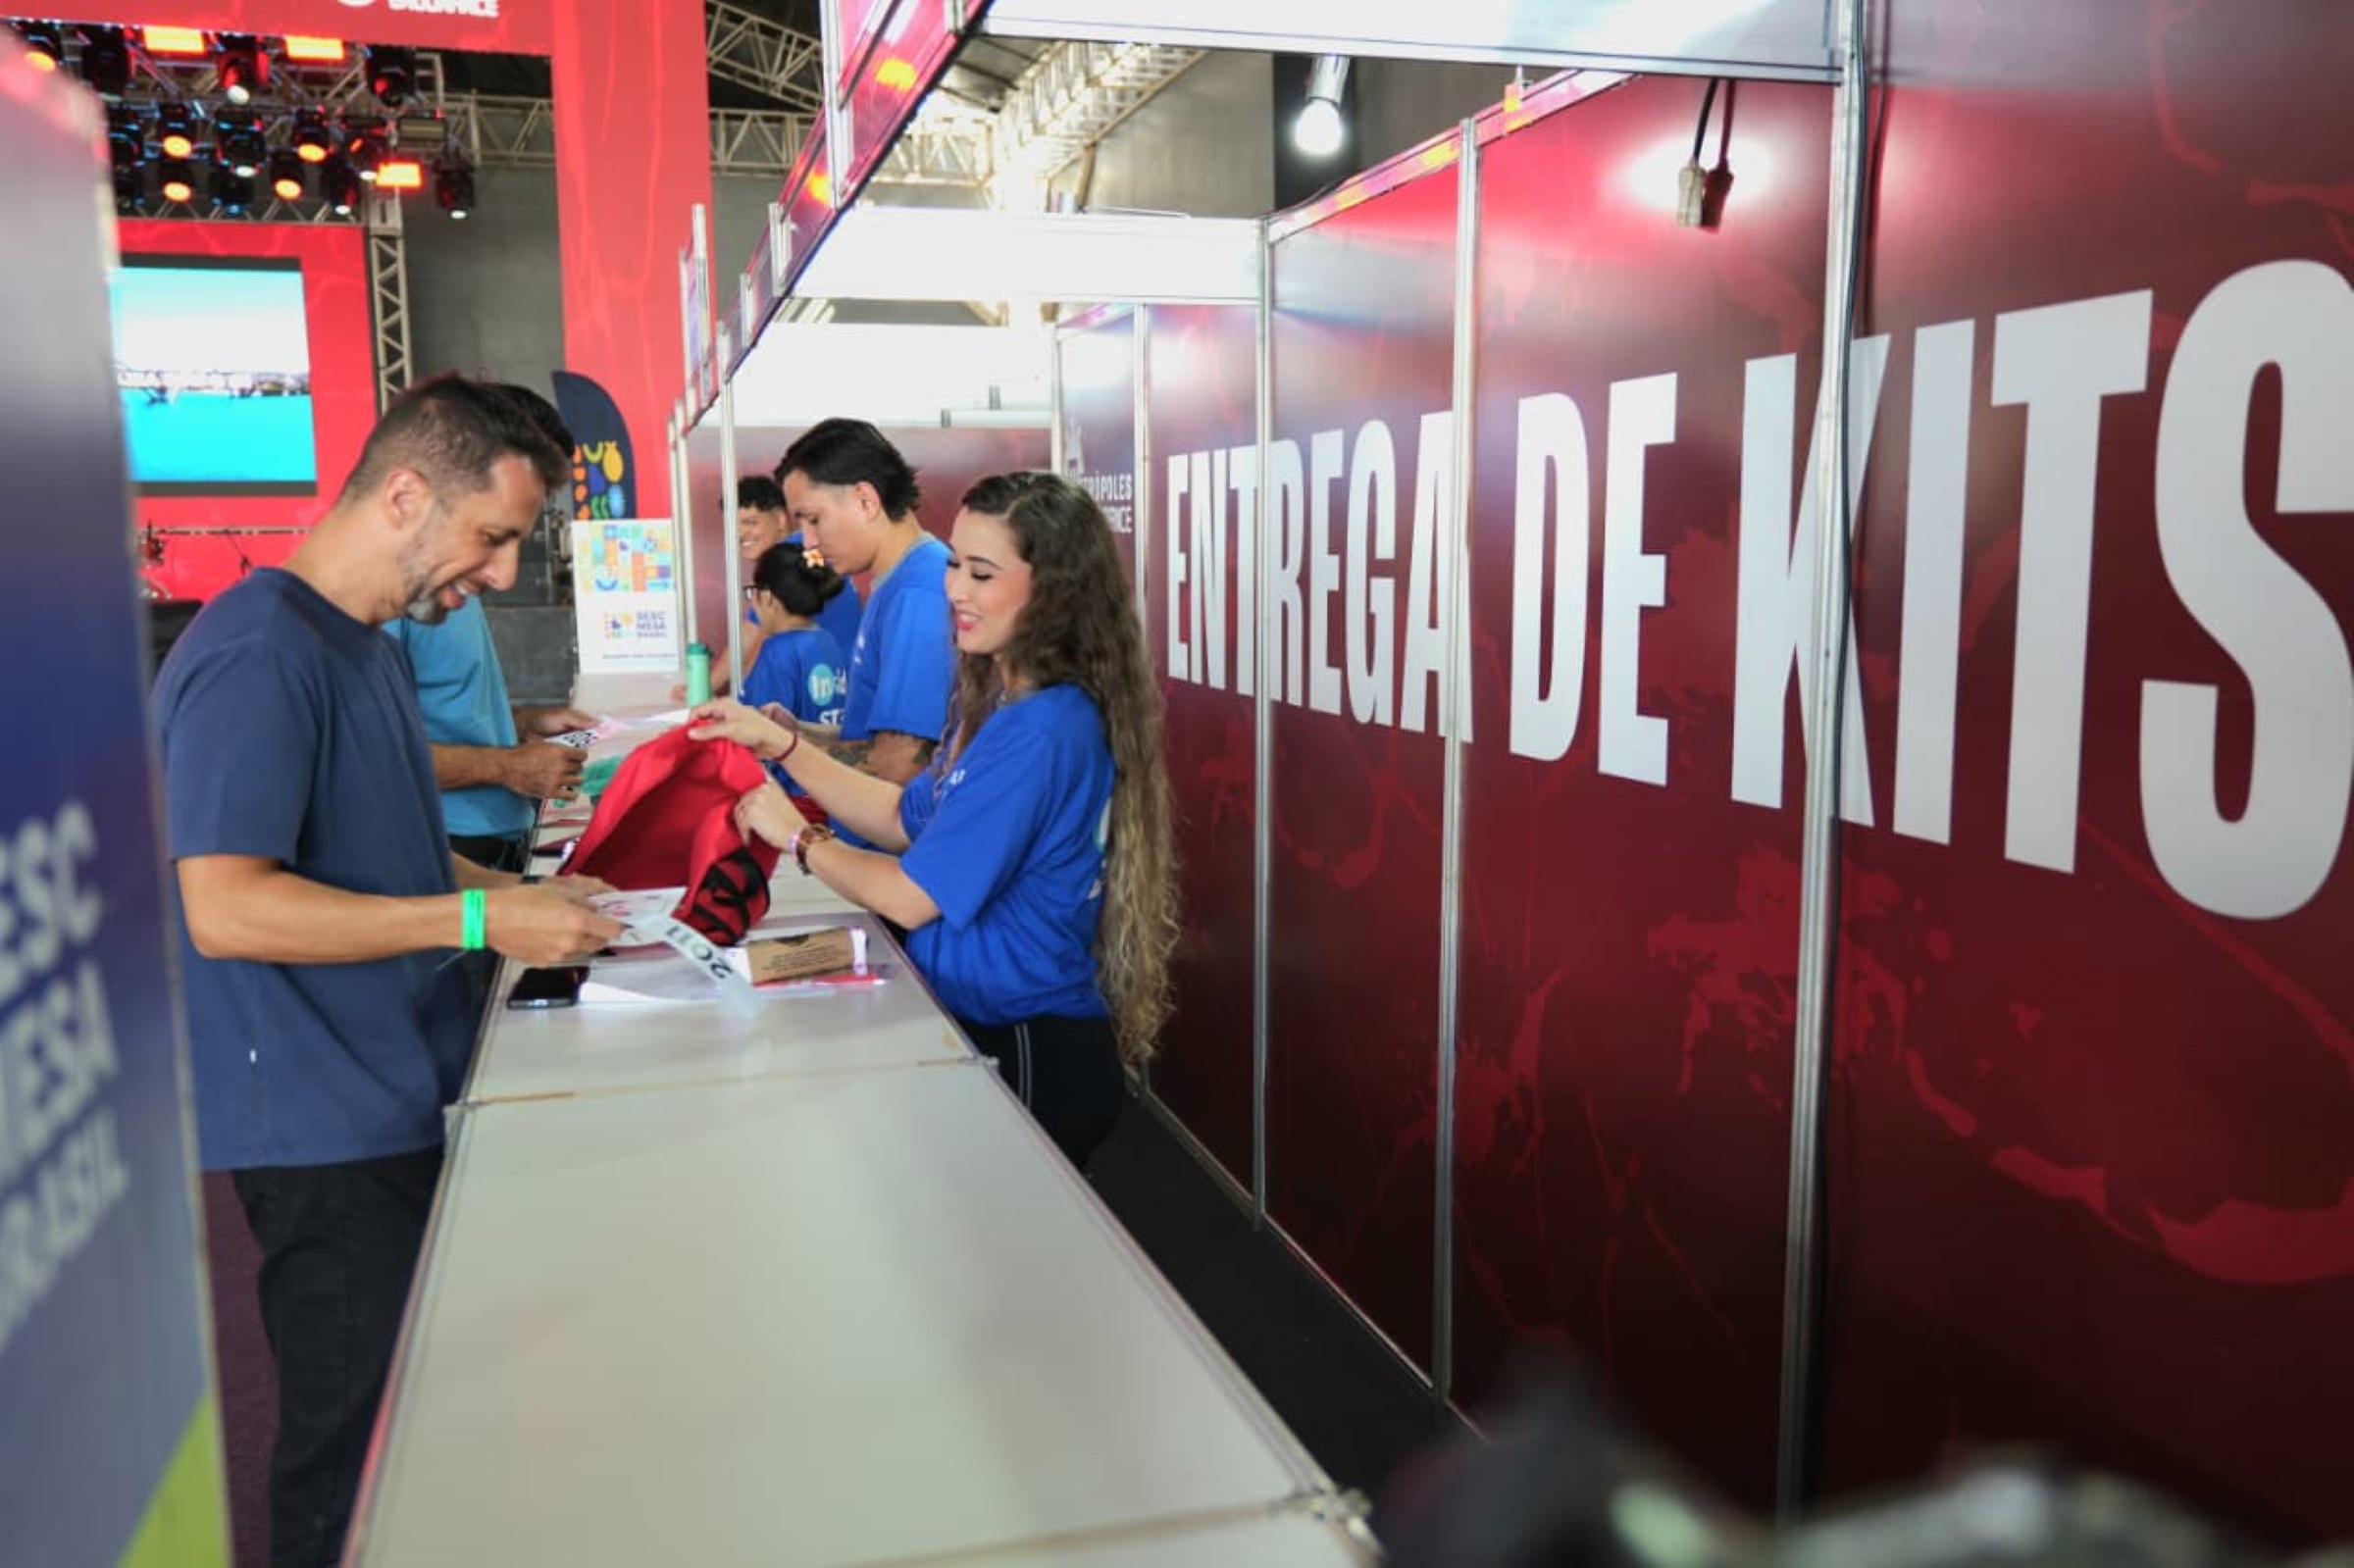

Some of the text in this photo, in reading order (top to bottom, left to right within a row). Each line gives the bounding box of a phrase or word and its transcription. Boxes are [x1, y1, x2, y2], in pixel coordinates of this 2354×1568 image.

[1167, 259, 2354, 920] ENTREGA DE KITS
[0, 958, 119, 1187] ESA
